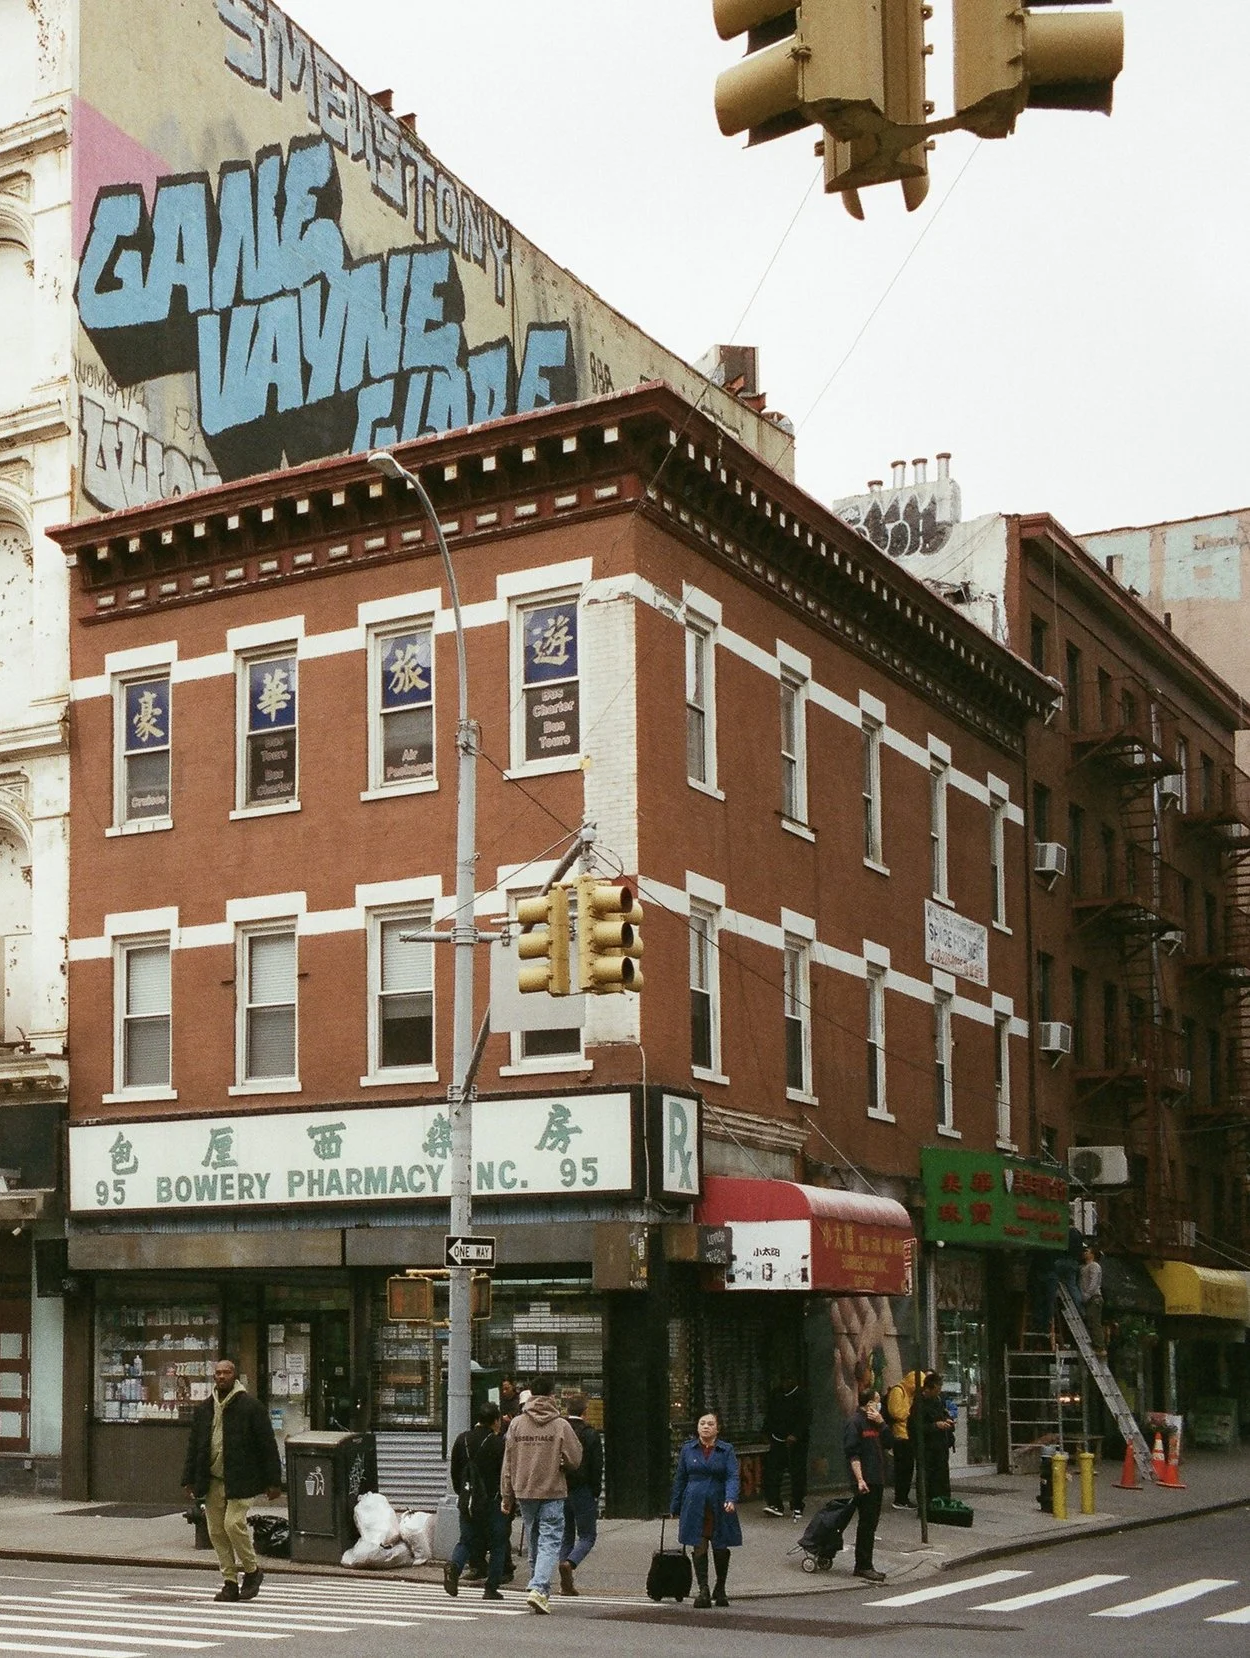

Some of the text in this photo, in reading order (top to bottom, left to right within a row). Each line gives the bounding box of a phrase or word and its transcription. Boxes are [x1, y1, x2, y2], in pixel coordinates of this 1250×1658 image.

[256, 667, 292, 722] 華
[388, 644, 429, 695] 旅
[538, 735, 571, 749] Tours
[95, 1157, 599, 1206] 95 BOWERY PHARMACY NC. 95
[453, 1245, 490, 1258] ONE WAY
